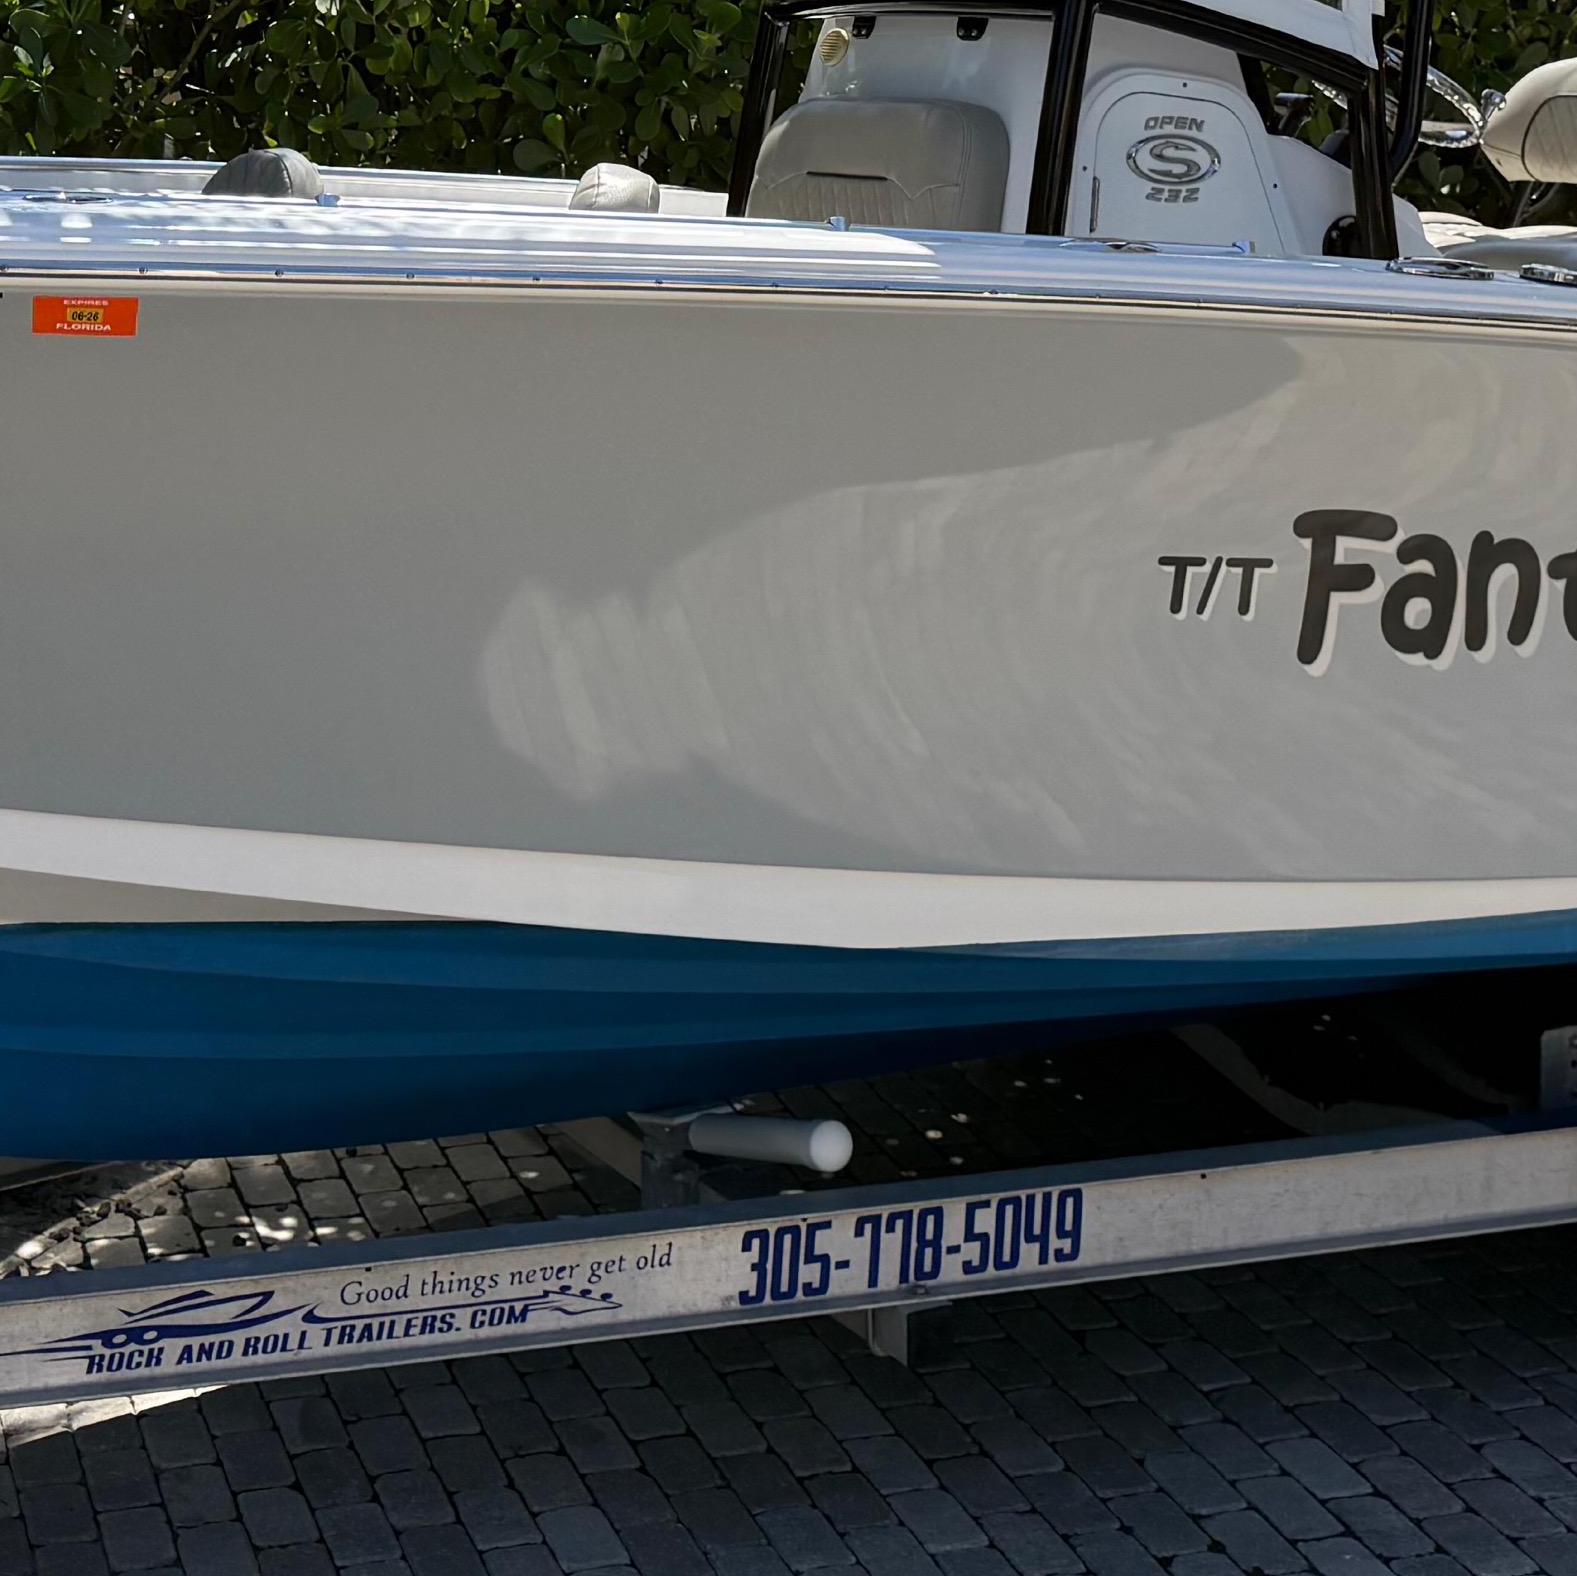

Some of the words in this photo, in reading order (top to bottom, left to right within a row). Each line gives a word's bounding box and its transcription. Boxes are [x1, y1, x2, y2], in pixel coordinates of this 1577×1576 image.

[1143, 115, 1205, 133] OPEN
[1145, 186, 1201, 204] 232
[63, 298, 109, 306] EXPIRES
[71, 310, 100, 322] 06-26
[55, 322, 112, 332] FLORIDA
[1157, 555, 1275, 619] T/T
[738, 1188, 1084, 1307] 305-778-5049
[339, 1274, 410, 1306] Good
[420, 1270, 500, 1299] things
[509, 1262, 580, 1286] never
[587, 1254, 627, 1285] get
[635, 1241, 673, 1271] old
[85, 1346, 166, 1375] ROCK
[175, 1338, 235, 1366] AND
[241, 1329, 313, 1357] ROLL
